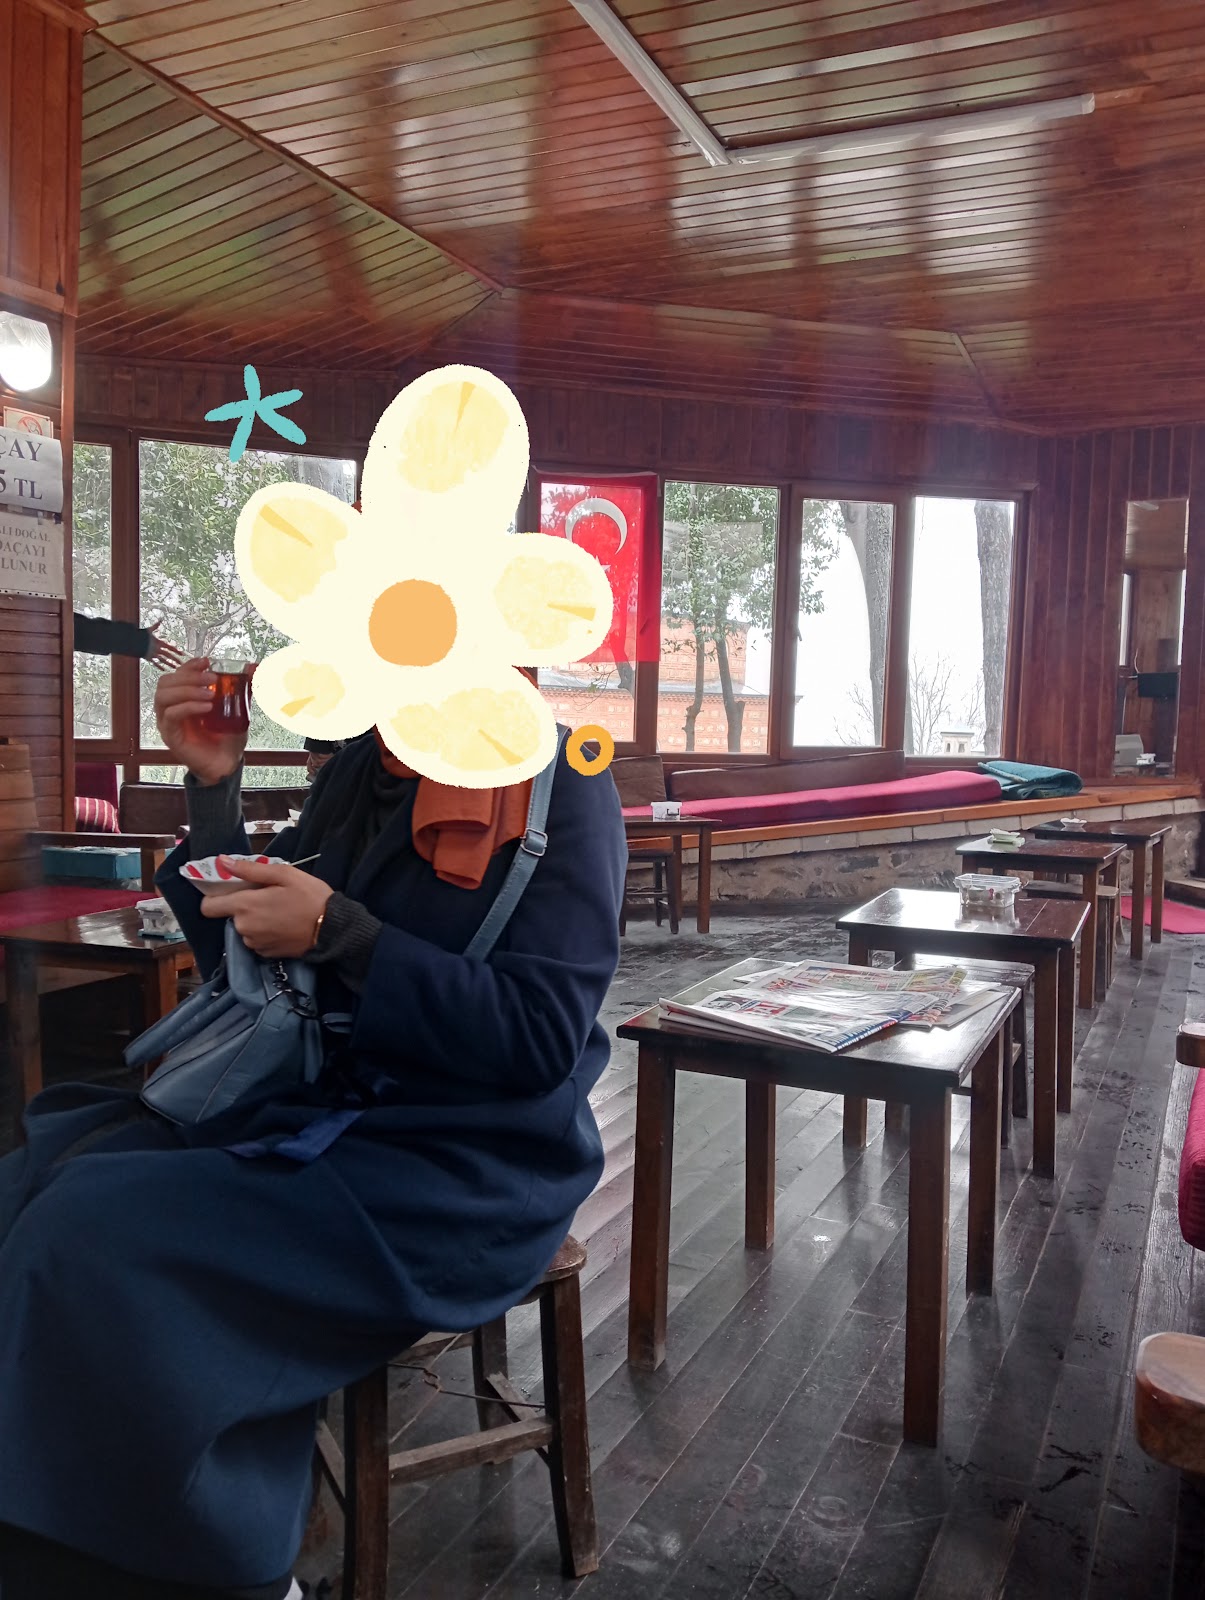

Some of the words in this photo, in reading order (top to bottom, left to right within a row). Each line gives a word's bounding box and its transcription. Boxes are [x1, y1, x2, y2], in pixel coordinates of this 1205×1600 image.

[13, 477, 43, 500] TL
[0, 525, 12, 536] LI
[15, 528, 50, 542] DOĞAL
[0, 541, 45, 557] AÇAYI
